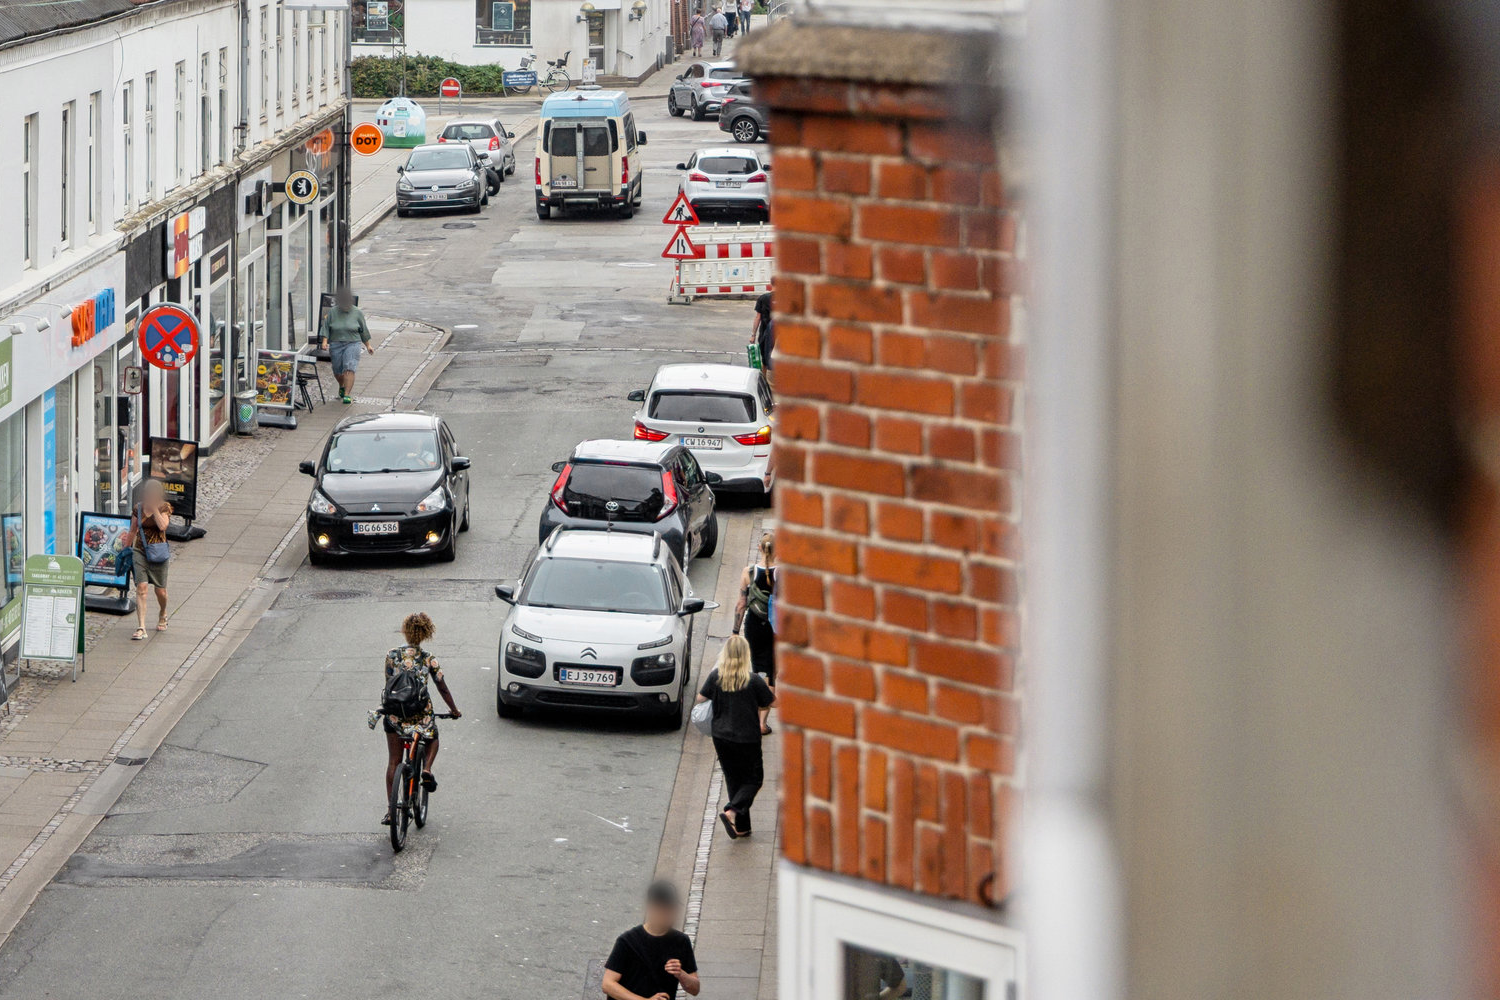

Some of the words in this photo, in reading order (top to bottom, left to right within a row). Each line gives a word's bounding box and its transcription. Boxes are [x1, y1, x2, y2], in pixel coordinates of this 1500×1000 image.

[356, 137, 378, 146] DOT
[685, 438, 696, 446] CW
[163, 483, 185, 492] MASH
[359, 524, 370, 532] BG
[371, 524, 381, 532] 66
[382, 523, 397, 532] 586
[567, 671, 580, 681] EJ
[582, 672, 594, 682] 39
[596, 673, 614, 683] 769
